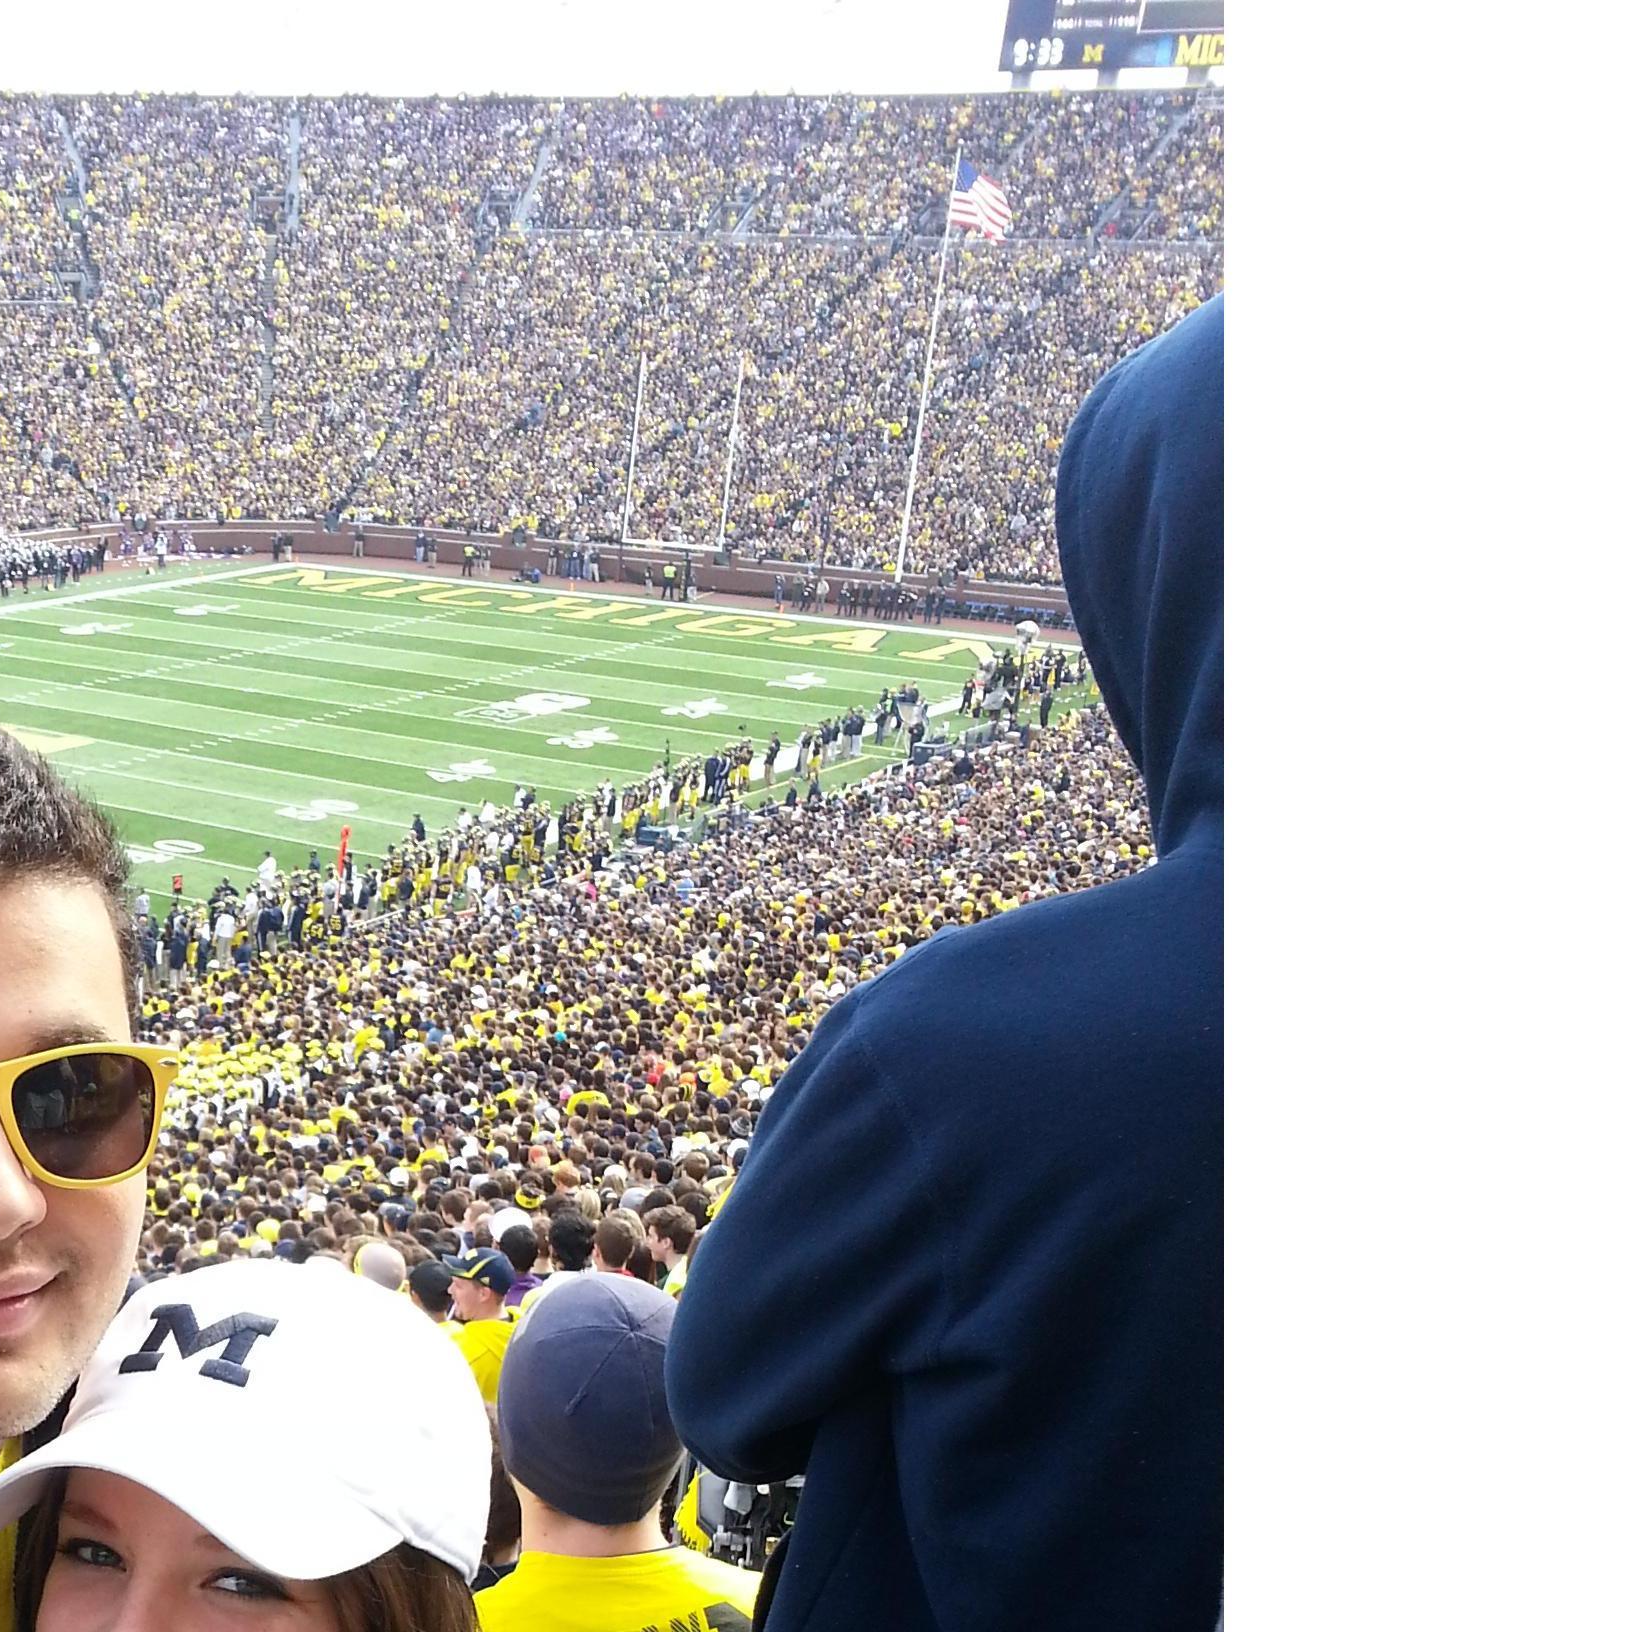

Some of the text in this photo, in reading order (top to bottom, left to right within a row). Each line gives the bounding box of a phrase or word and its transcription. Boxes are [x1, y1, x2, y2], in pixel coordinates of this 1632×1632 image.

[1013, 38, 1064, 66] 9:33
[1082, 44, 1104, 63] M
[118, 1303, 280, 1388] M
